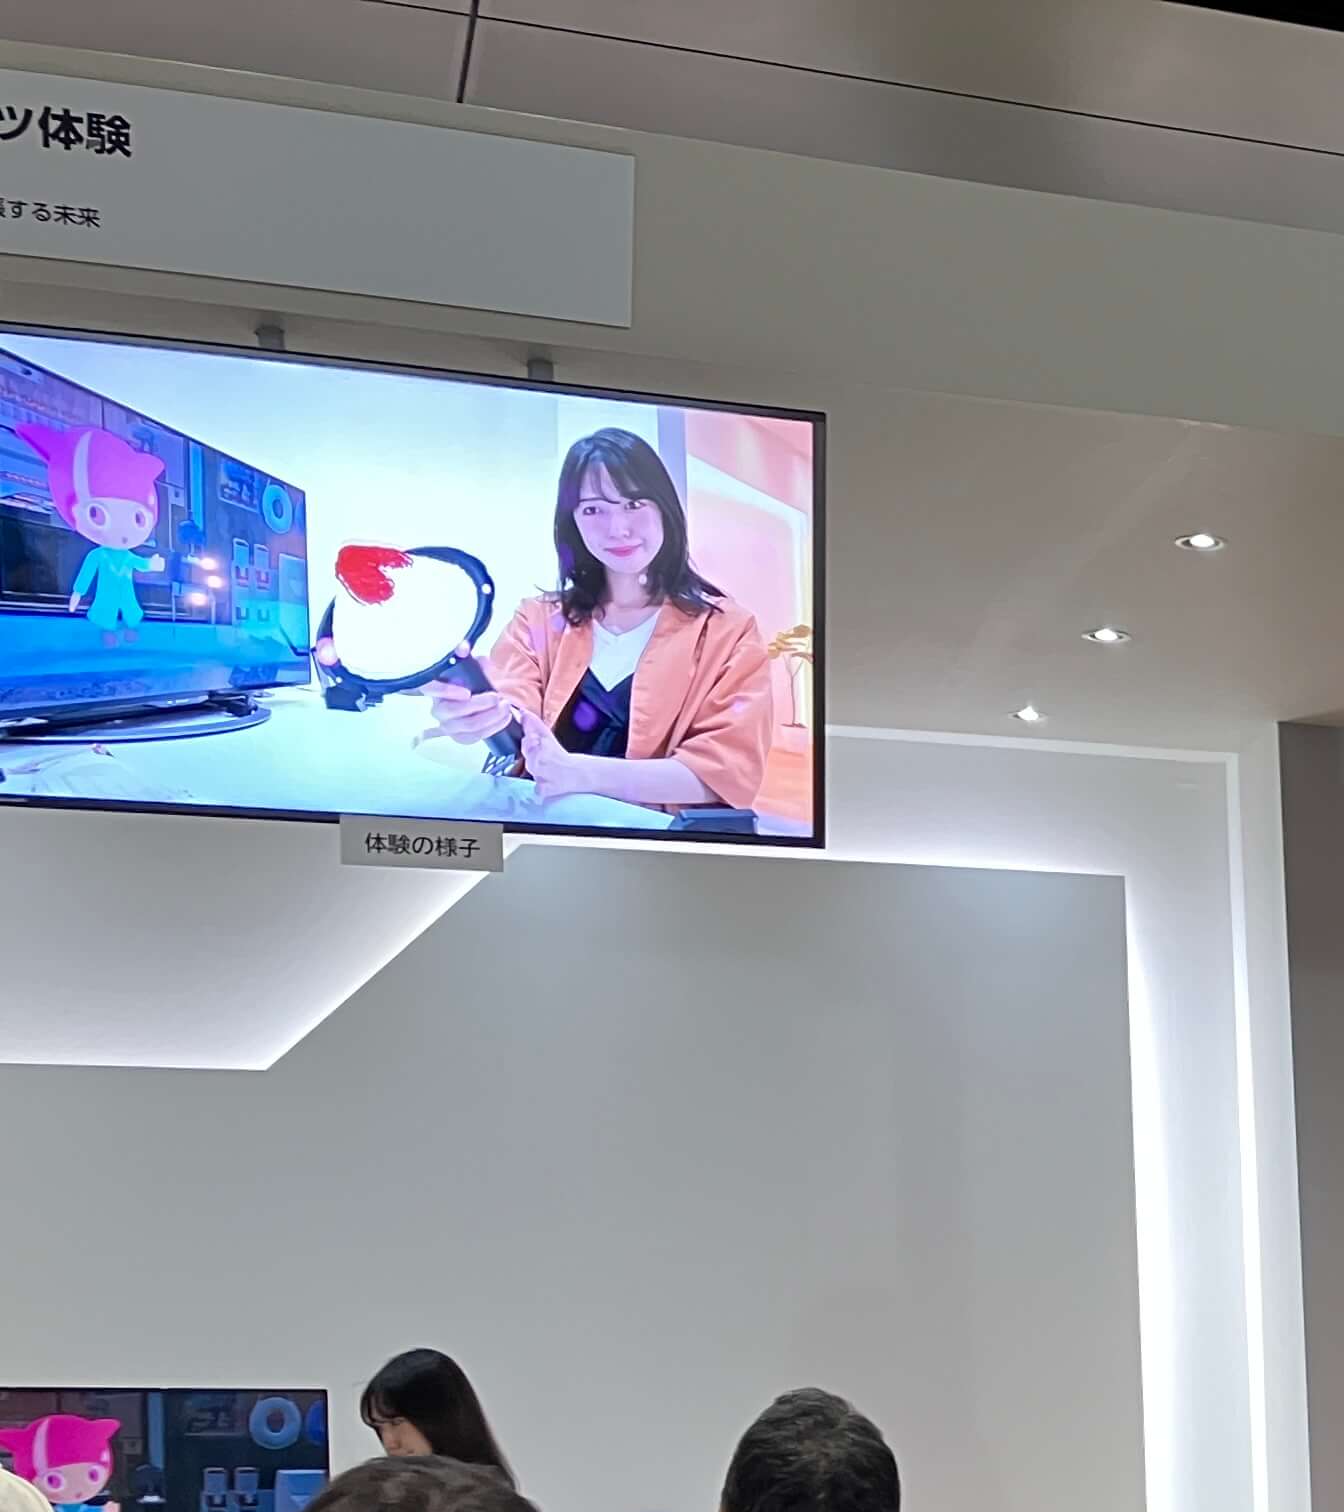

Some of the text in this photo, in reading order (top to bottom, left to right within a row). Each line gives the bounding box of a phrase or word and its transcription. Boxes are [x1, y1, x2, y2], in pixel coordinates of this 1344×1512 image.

[364, 832, 480, 858] 体験の様子
